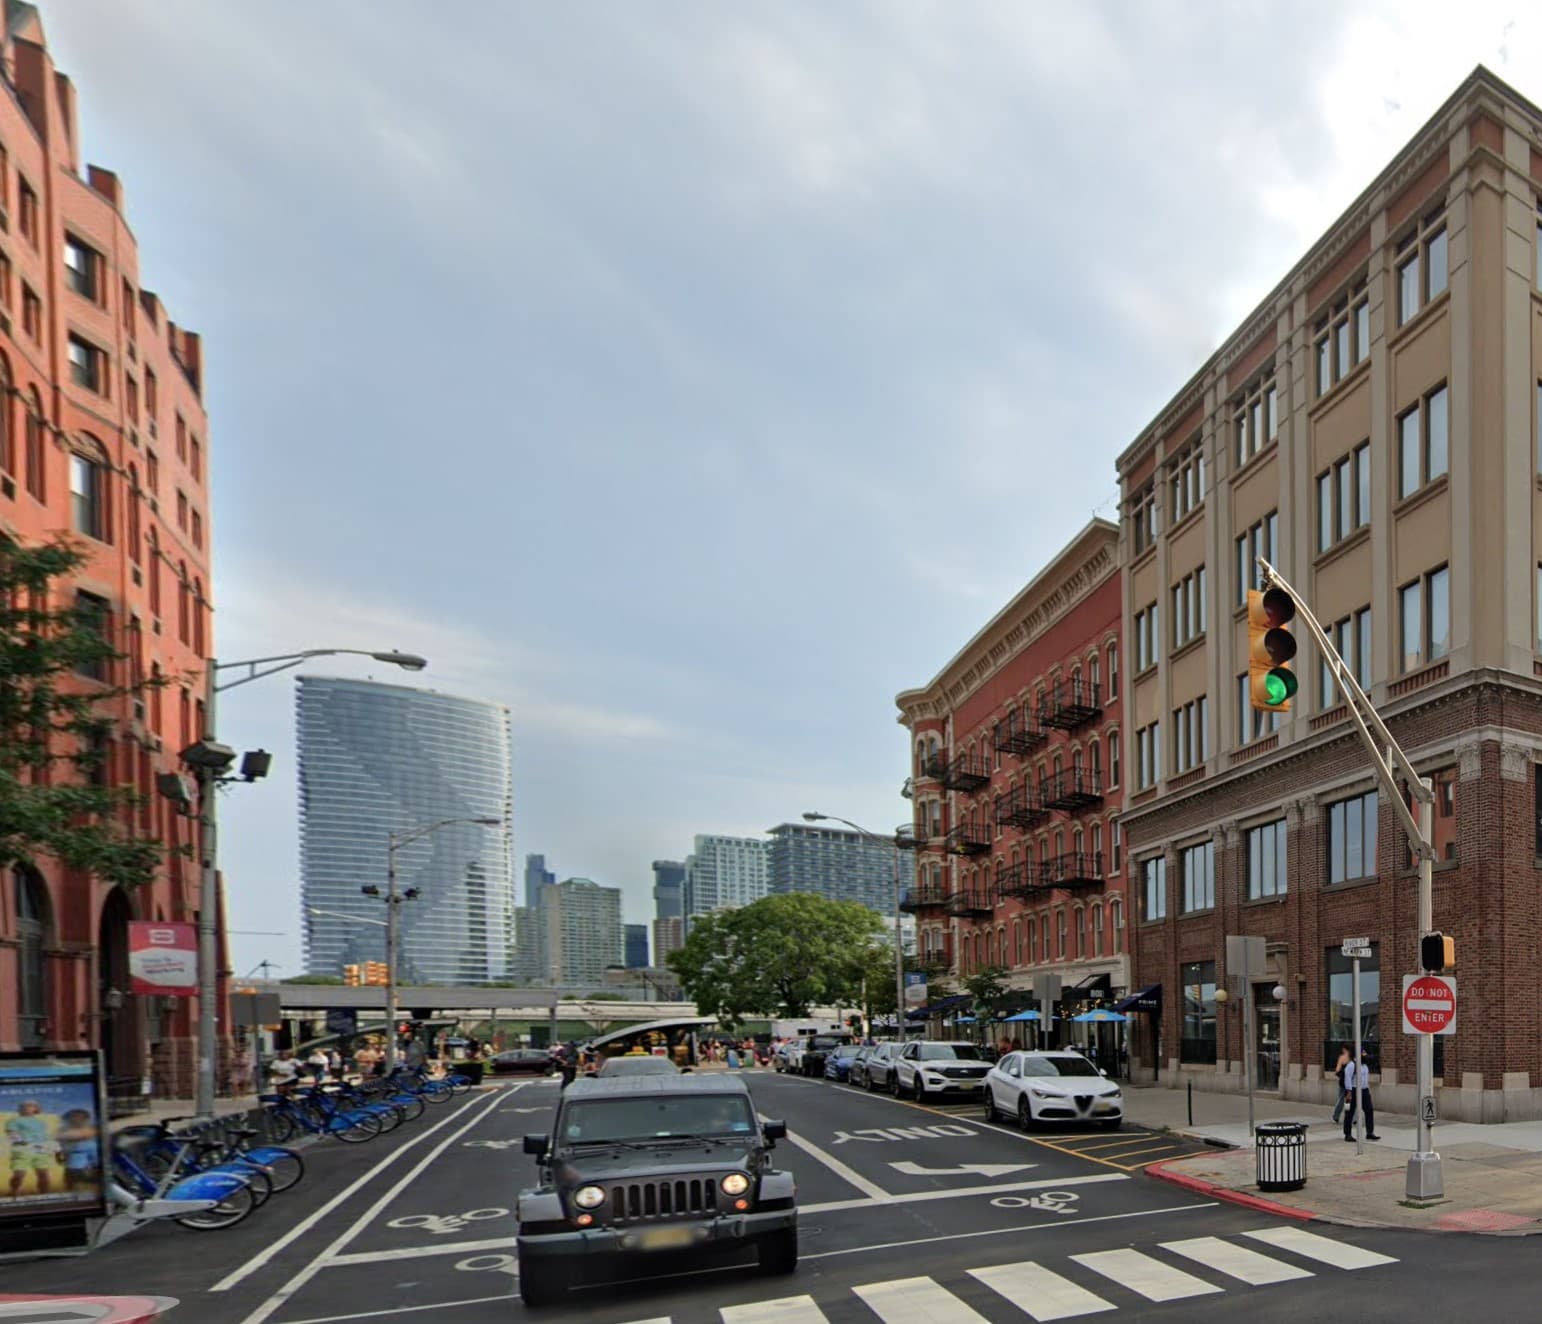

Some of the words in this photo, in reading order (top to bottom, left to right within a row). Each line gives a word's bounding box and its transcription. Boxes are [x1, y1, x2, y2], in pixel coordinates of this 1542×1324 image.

[1411, 988, 1424, 997] DO
[1430, 988, 1448, 997] NOT
[1415, 1013, 1445, 1022] ENTER
[832, 1125, 979, 1144] ONLY
